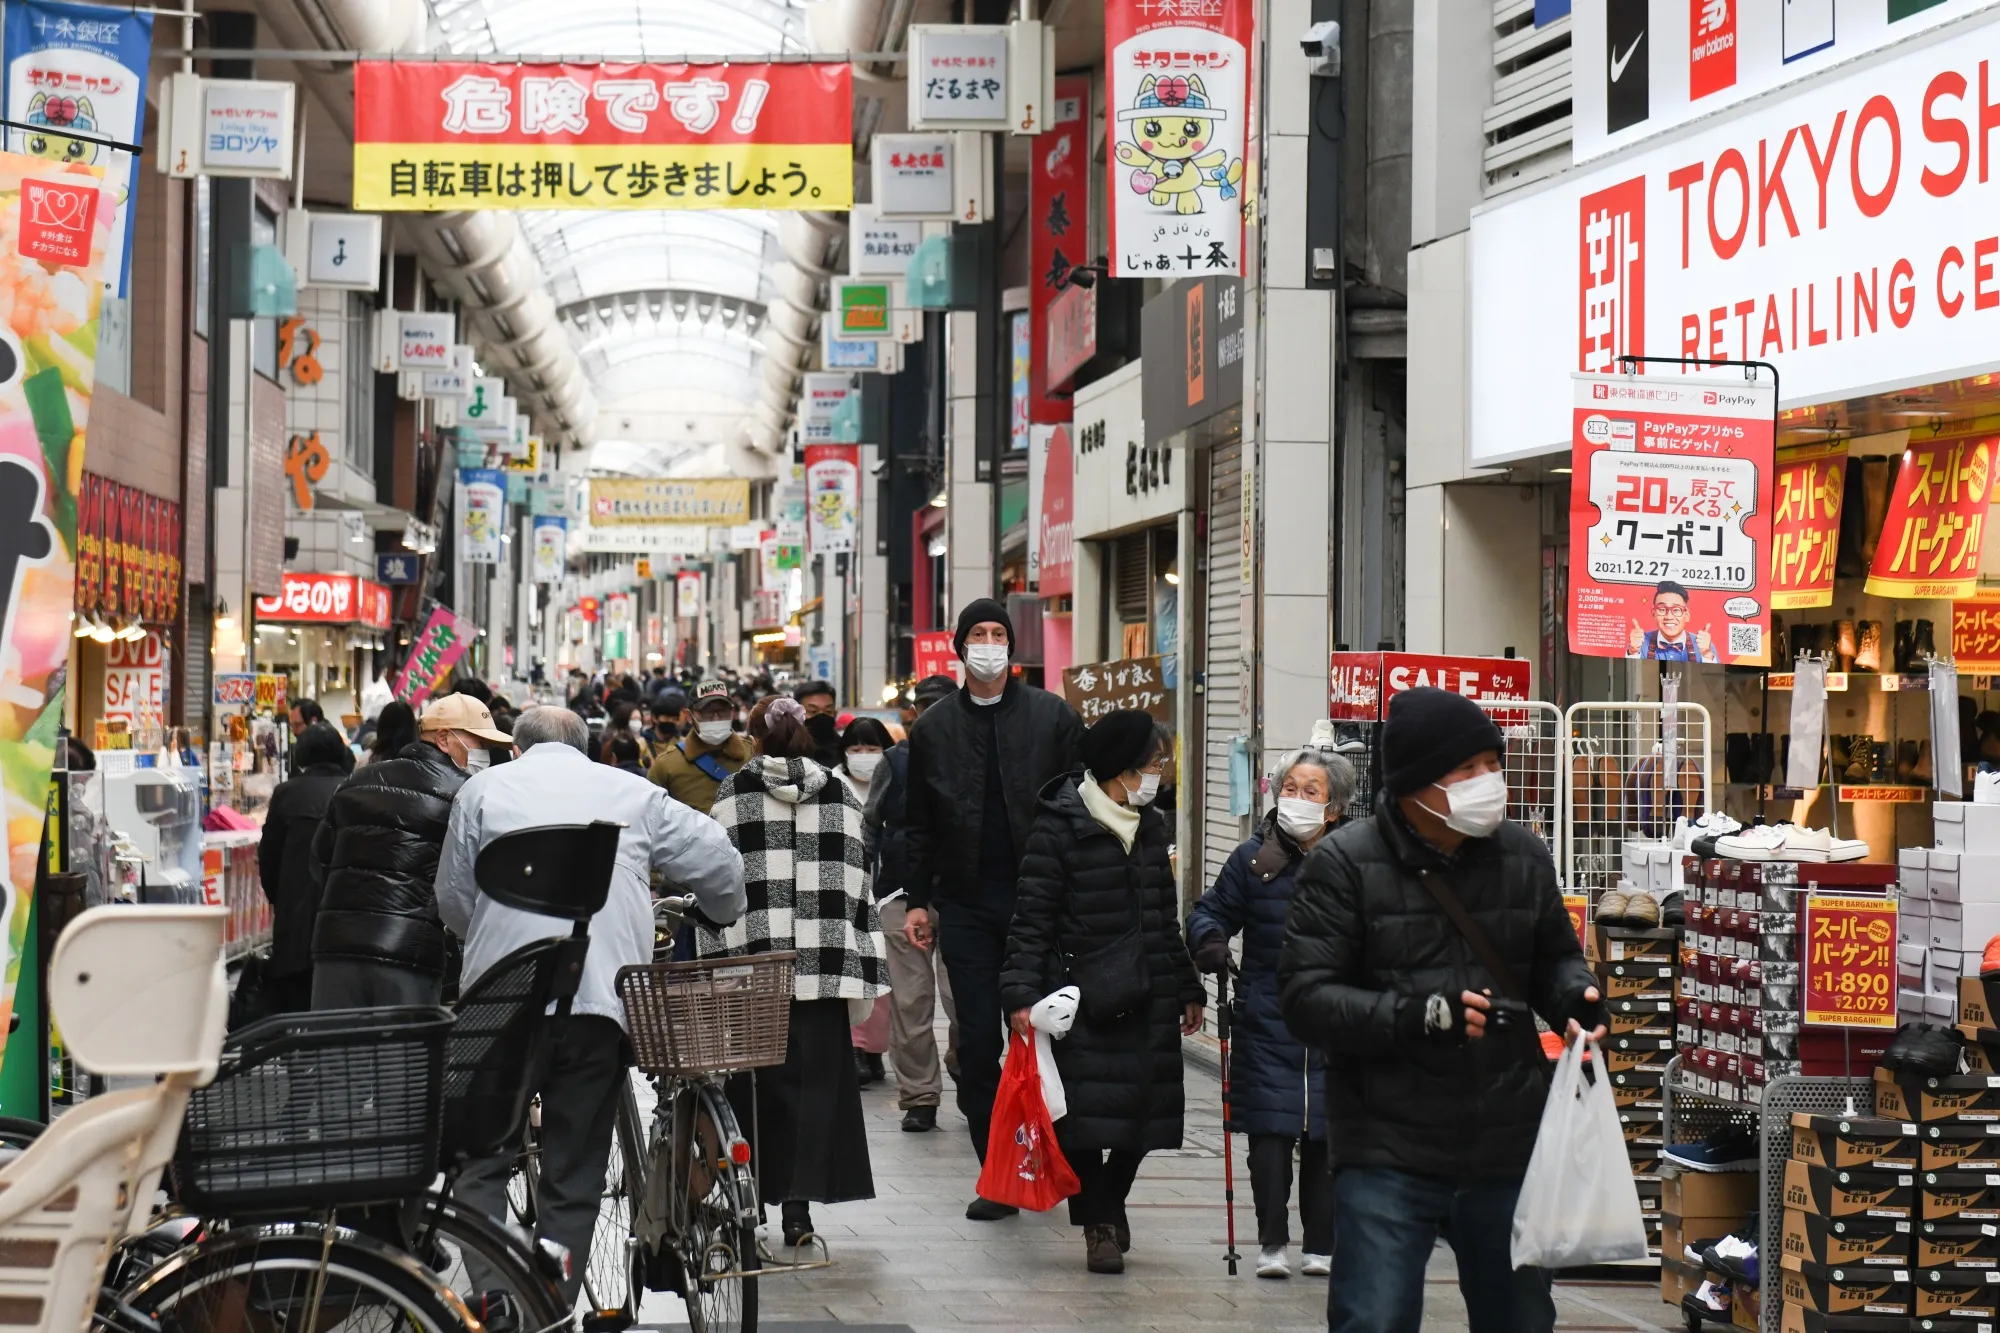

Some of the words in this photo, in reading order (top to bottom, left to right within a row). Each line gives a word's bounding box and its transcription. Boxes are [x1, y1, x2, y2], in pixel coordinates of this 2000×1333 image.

[1692, 44, 1706, 63] new
[1706, 32, 1734, 57] balance
[1132, 51, 1231, 69] キタニャン
[26, 69, 122, 95] キタニャン
[926, 77, 1001, 100] だるまや
[389, 160, 822, 199] 自転車は押して歩きましょう。
[1668, 95, 1902, 270] TOKYO
[32, 241, 79, 257] チカラになる
[41, 231, 73, 243] #外食は
[1127, 241, 1237, 271] じゃあ、十条。
[1681, 258, 1916, 374] RETAILING
[1718, 394, 1756, 407] PayPay
[1643, 421, 1745, 438] PayPayアプリから
[1643, 436, 1719, 453] 事前にゲット!
[1972, 446, 1987, 473] SUPER
[1908, 441, 1971, 508] スーパー
[1615, 475, 1690, 516] 20%
[1691, 478, 1736, 499] 戻って
[1775, 462, 1825, 526] スーパー
[1692, 499, 1721, 518] くる
[1616, 519, 1724, 557] クーポン
[1889, 512, 1983, 576] バーゲン!!
[1595, 559, 1670, 578] 2021.12.27
[1681, 564, 1746, 583] 2022.1.10
[1913, 584, 1930, 596] SUPER
[1955, 609, 1994, 631] スーパー
[107, 630, 162, 665] DVD
[1072, 663, 1155, 692] 香りが良く
[1492, 673, 1514, 688] セール
[1975, 677, 1988, 688] M
[217, 678, 254, 703] マスク
[1821, 899, 1844, 907] SUPER
[1845, 900, 1884, 909] BARGAIN!!
[1813, 916, 1868, 940] スーパー
[1870, 923, 1889, 934] SUPER
[1812, 942, 1890, 967] バーゲン!!
[1818, 1014, 1841, 1022] SUPER
[1842, 1015, 1882, 1025] BARGAIN!!
